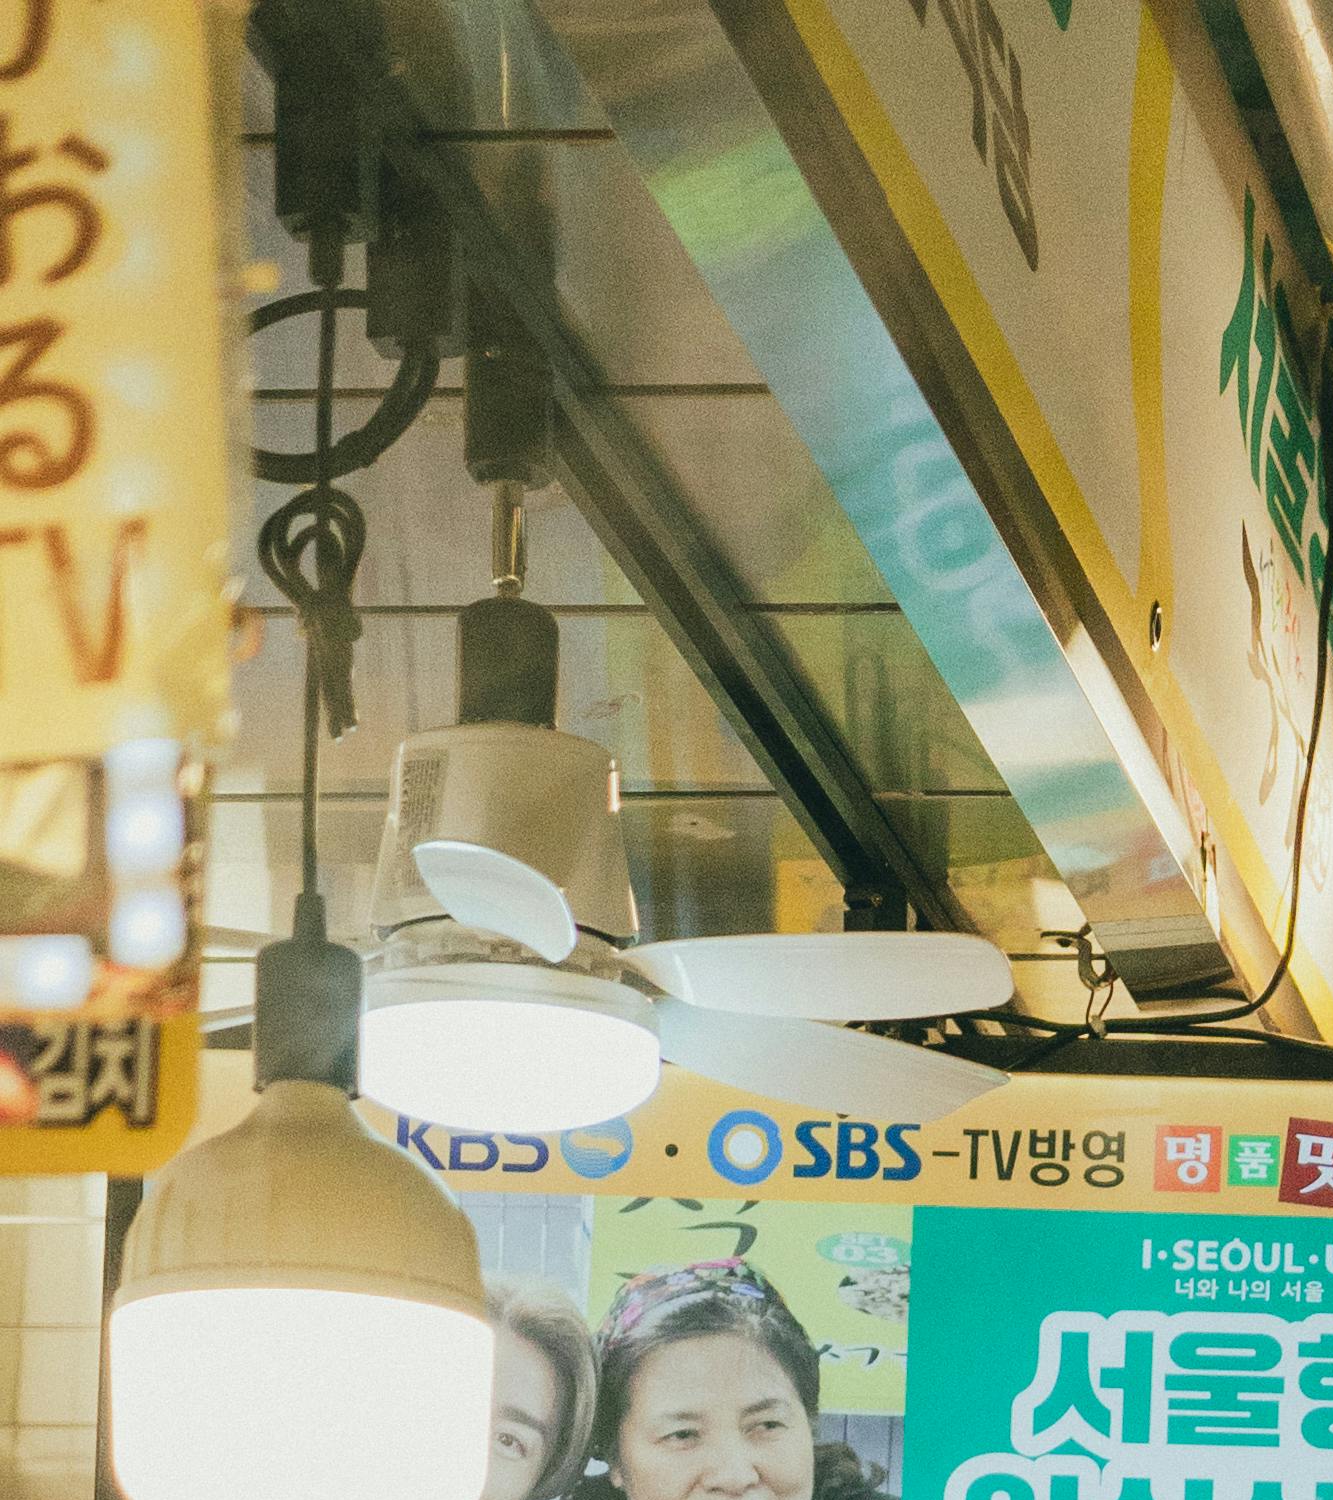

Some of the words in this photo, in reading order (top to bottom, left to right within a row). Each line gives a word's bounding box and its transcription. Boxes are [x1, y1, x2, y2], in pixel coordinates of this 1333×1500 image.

[1174, 1278, 1218, 1300] 너와
[1227, 1279, 1271, 1301] 나의
[1280, 1280, 1324, 1303] 서울
